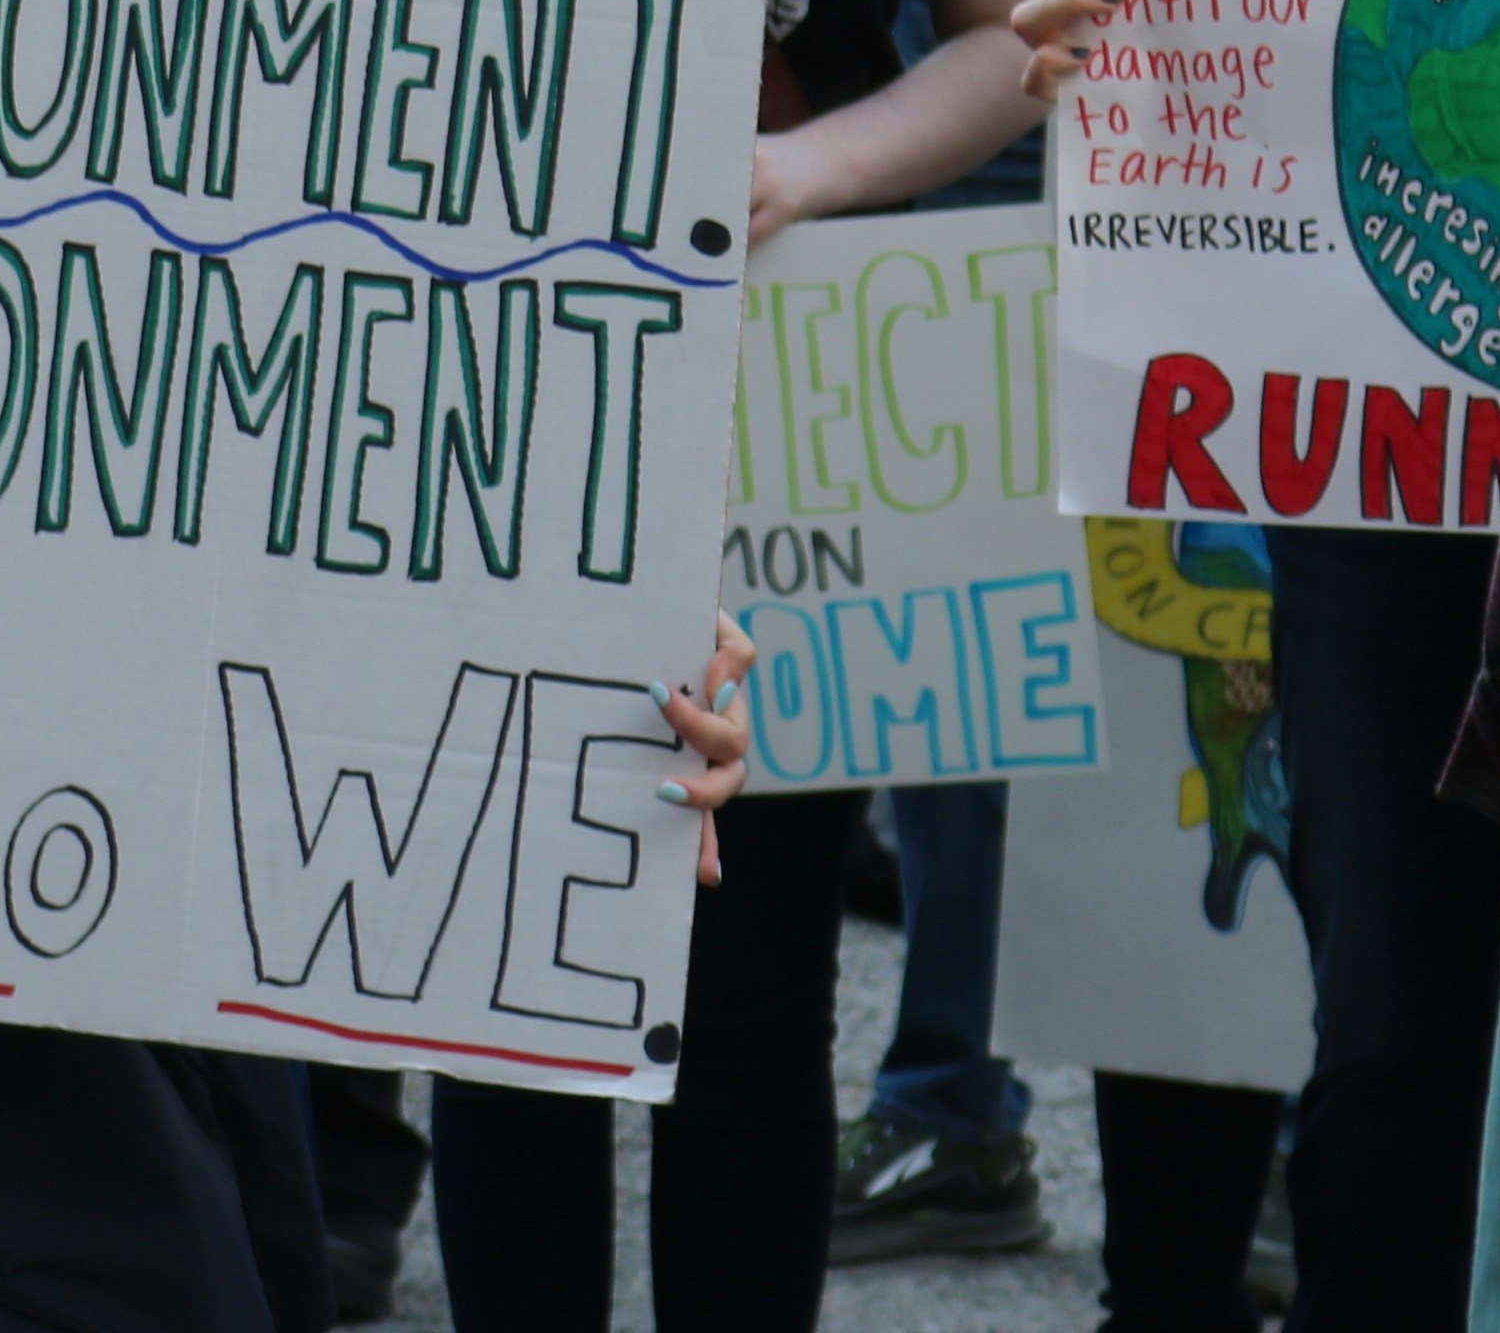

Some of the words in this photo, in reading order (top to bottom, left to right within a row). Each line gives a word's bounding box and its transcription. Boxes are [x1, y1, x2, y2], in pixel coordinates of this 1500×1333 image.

[1084, 39, 1275, 99] damage
[1074, 95, 1129, 139] to
[1159, 92, 1246, 140] the
[1090, 147, 1227, 189] Earth
[1252, 142, 1297, 193] is
[1069, 212, 1336, 254] IRREVERSIBLE.
